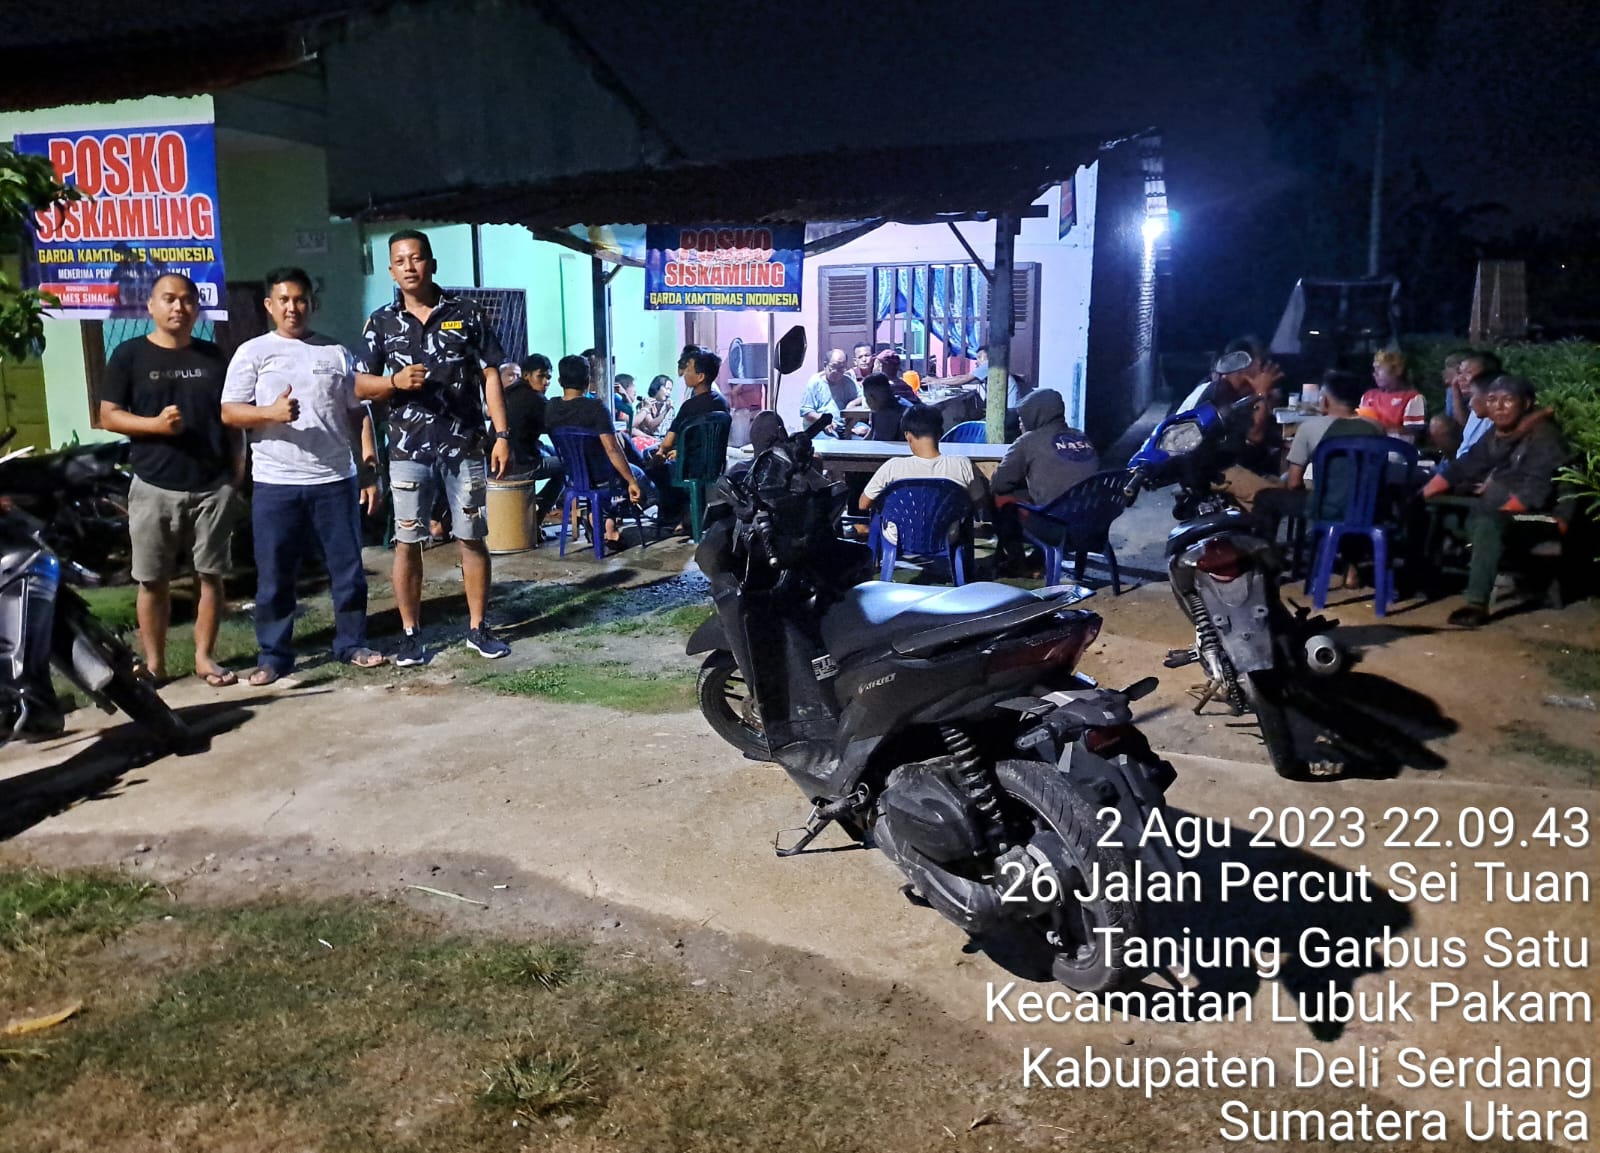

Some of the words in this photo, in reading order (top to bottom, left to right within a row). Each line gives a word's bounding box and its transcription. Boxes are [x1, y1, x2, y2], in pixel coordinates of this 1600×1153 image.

[49, 131, 188, 196] POSKO
[35, 193, 215, 242] SISKAMLING
[39, 249, 75, 263] GARDA
[680, 228, 774, 260] POSKO
[665, 262, 785, 287] SISKAMLING
[650, 292, 682, 306] GARDA
[685, 292, 743, 305] KAMTIBMAS
[746, 292, 799, 305] INDONESIA
[1056, 441, 1094, 450] NASA
